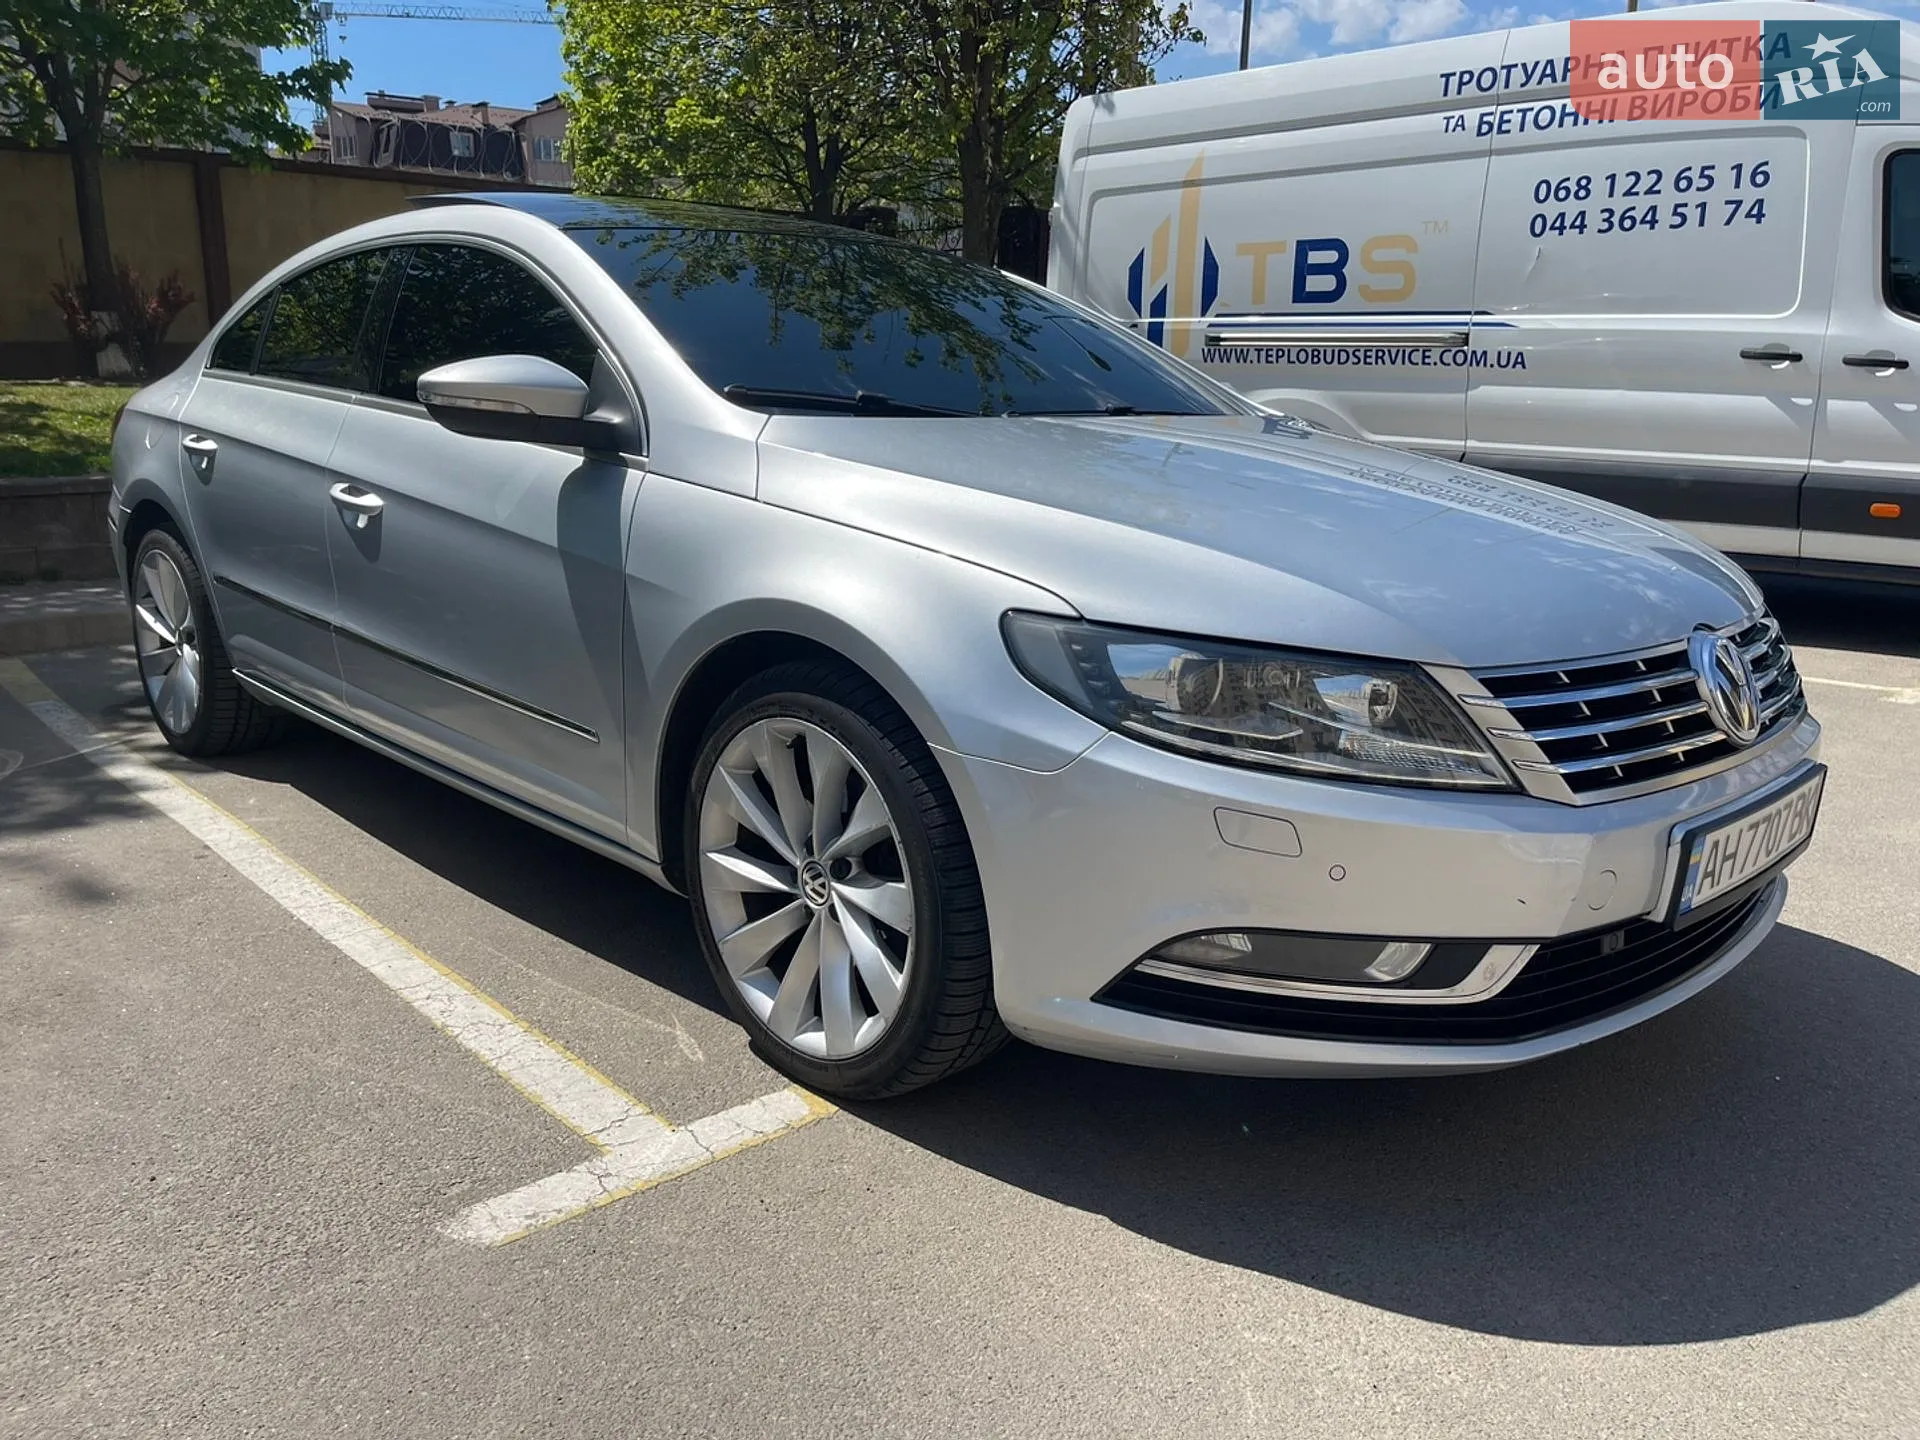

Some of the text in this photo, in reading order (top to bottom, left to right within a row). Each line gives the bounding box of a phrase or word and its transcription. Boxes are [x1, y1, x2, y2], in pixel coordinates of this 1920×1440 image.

[1443, 83, 1783, 137] ТА БЕТОННІ ВИРОБИ
[1533, 160, 1771, 205] 068 122 65 16
[1529, 198, 1767, 239] 044 364 51 74
[1236, 234, 1420, 307] TBS
[1201, 347, 1527, 370] WWW.TEPLOBUDSERVICE.COM.UA
